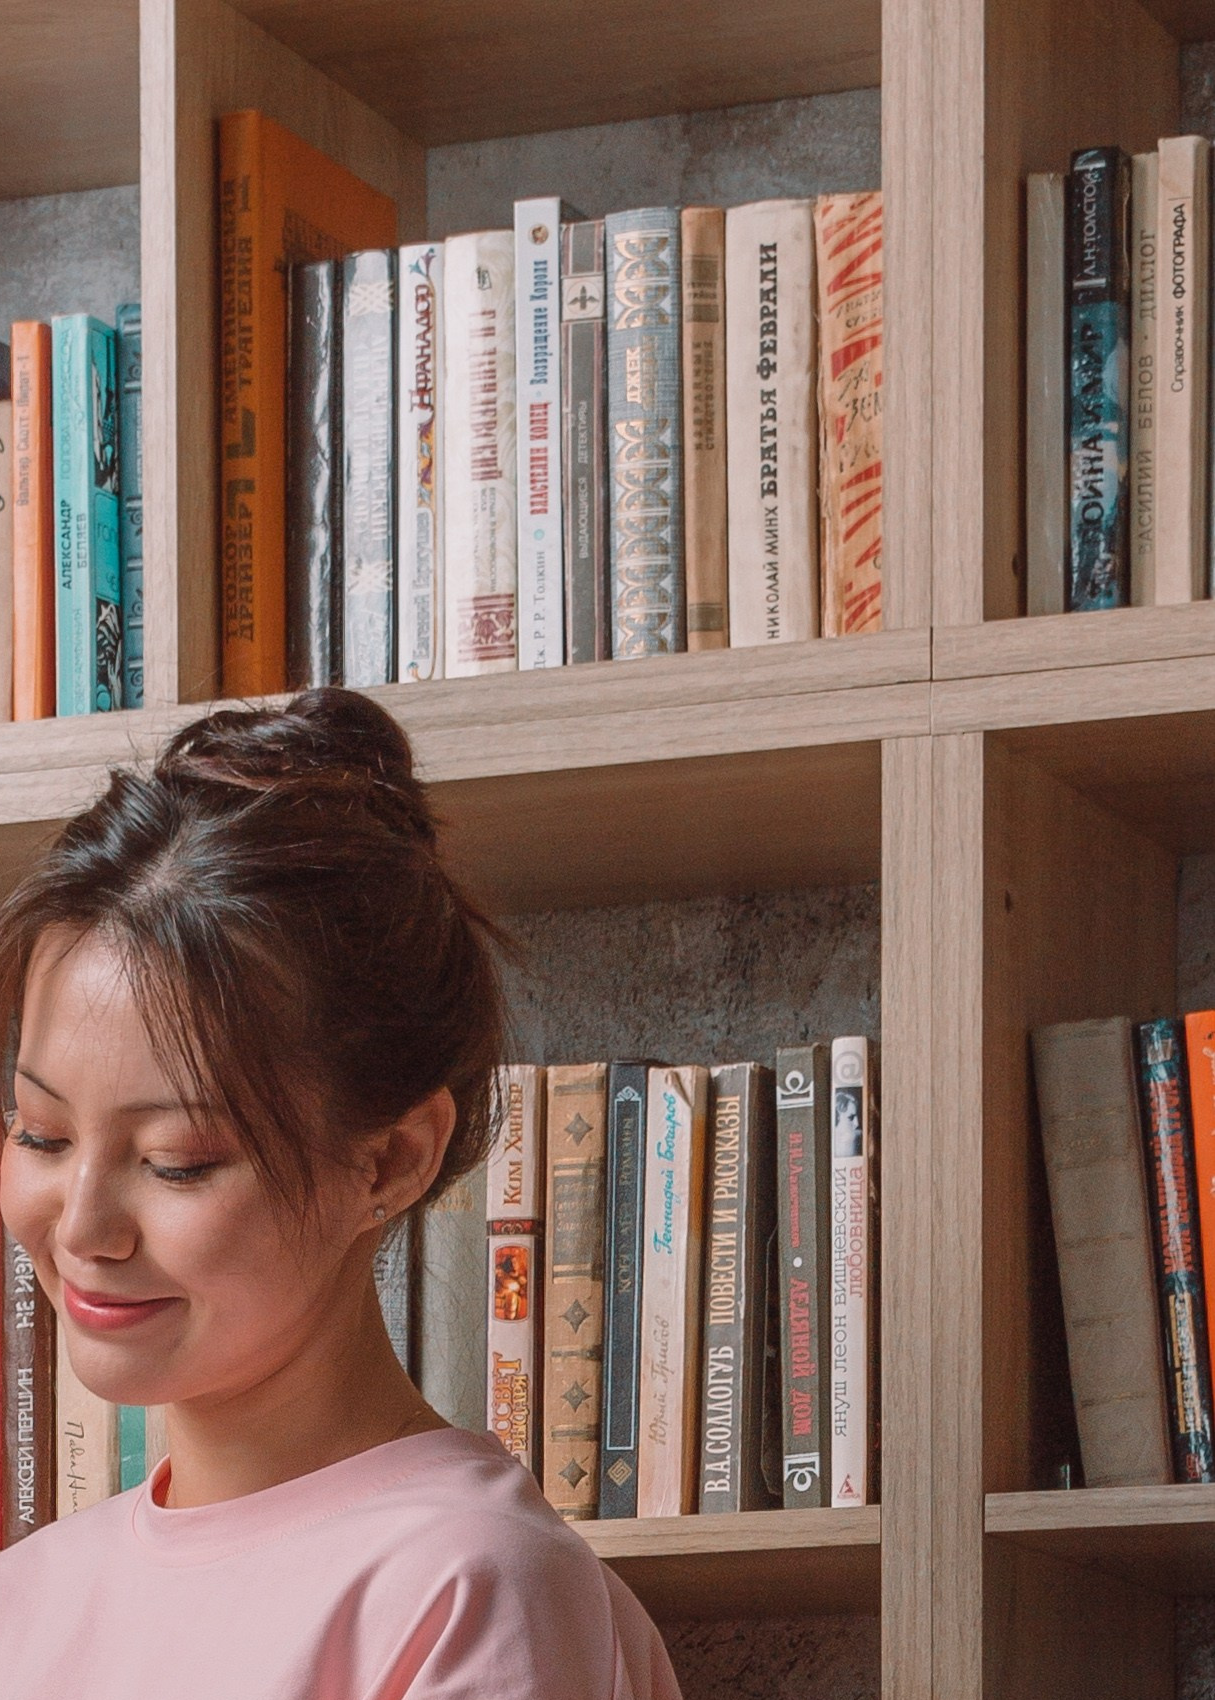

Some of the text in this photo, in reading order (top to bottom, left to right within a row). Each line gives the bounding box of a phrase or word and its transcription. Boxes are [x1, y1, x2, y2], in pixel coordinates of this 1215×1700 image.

[223, 178, 238, 426] АМЕРИКАНСКАЯ
[238, 236, 254, 387] ТРАГЕДИЯ
[1139, 229, 1156, 320] ДИАЛОГ
[1171, 203, 1188, 392] Справочник ФОТОГРАФА
[529, 259, 552, 385] Возвращение Короля
[626, 347, 640, 404] ДЖЕК
[1136, 354, 1152, 429] БЕЛОВ
[17, 415, 31, 507] Вальтер Скотт
[529, 401, 552, 515] ВЛАСТЕЛИН КОЛЕЦ
[756, 242, 781, 640] НИКОЛАЙ МИНХ БРАТЬЯ ФЕВРАЛИ
[59, 499, 73, 590] АЛЕКСАНДР
[77, 512, 88, 569] БЕЛЯЕВ
[224, 524, 238, 643] ТЕОДОР
[530, 550, 545, 604] Толкин
[503, 1160, 524, 1207] Ким
[655, 1169, 677, 1256] Геннадий
[710, 1096, 741, 1327] ПОВЕСТИ И РАССКАЗЫ
[15, 1300, 35, 1330] НЕ
[787, 1276, 816, 1435] ЛЕДЯНОЙ ДОМ
[15, 1368, 35, 1524] АЛЕКСЕЙ ПЕРШИН
[648, 1391, 669, 1447] Юрий
